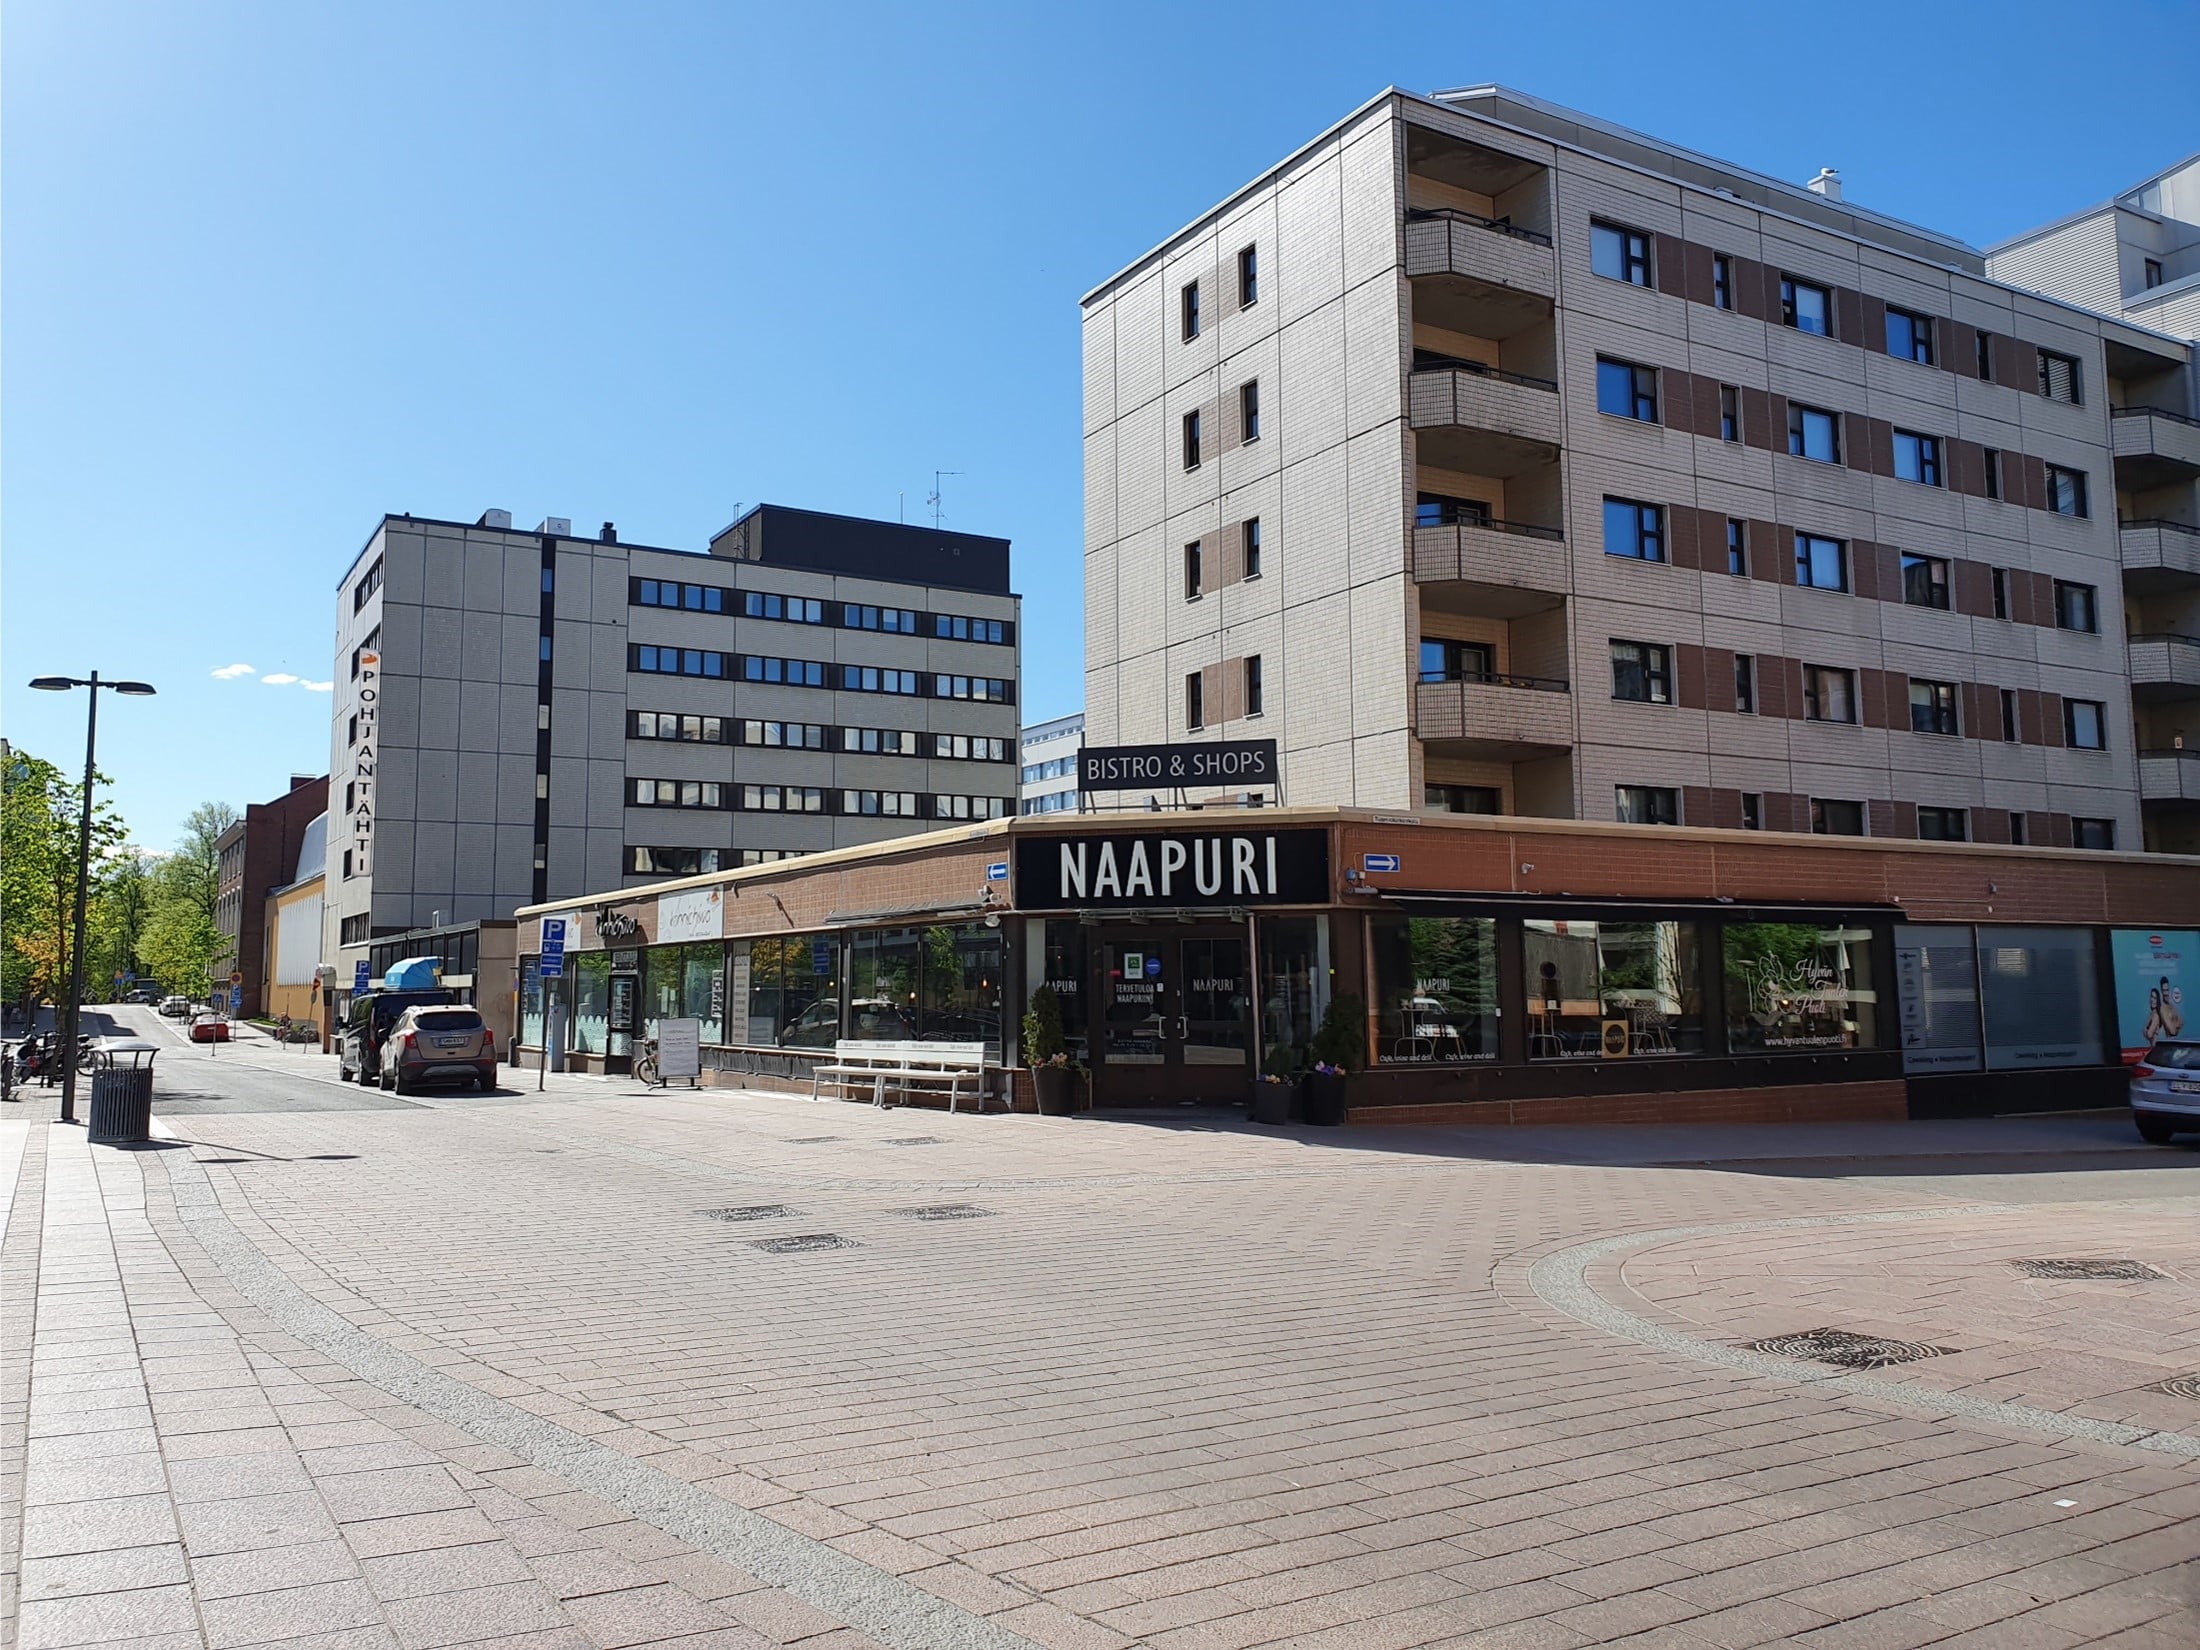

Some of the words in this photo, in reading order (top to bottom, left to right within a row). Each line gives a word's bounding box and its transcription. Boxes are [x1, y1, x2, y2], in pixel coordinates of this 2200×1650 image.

[356, 670, 376, 871] POHJANTÄHTI
[1087, 755, 1162, 780] BISTRO
[1169, 754, 1185, 777] &
[1193, 751, 1265, 776] SHOPS
[1060, 836, 1277, 899] NAAPURI
[547, 920, 563, 938] P
[358, 961, 369, 972] P
[1789, 958, 1833, 984] Hyvän
[1115, 983, 1154, 993] TERVETULOA
[1192, 979, 1234, 992] NAAPURI
[1416, 978, 1450, 991] NAAPURI
[1794, 994, 1826, 1015] Puoti
